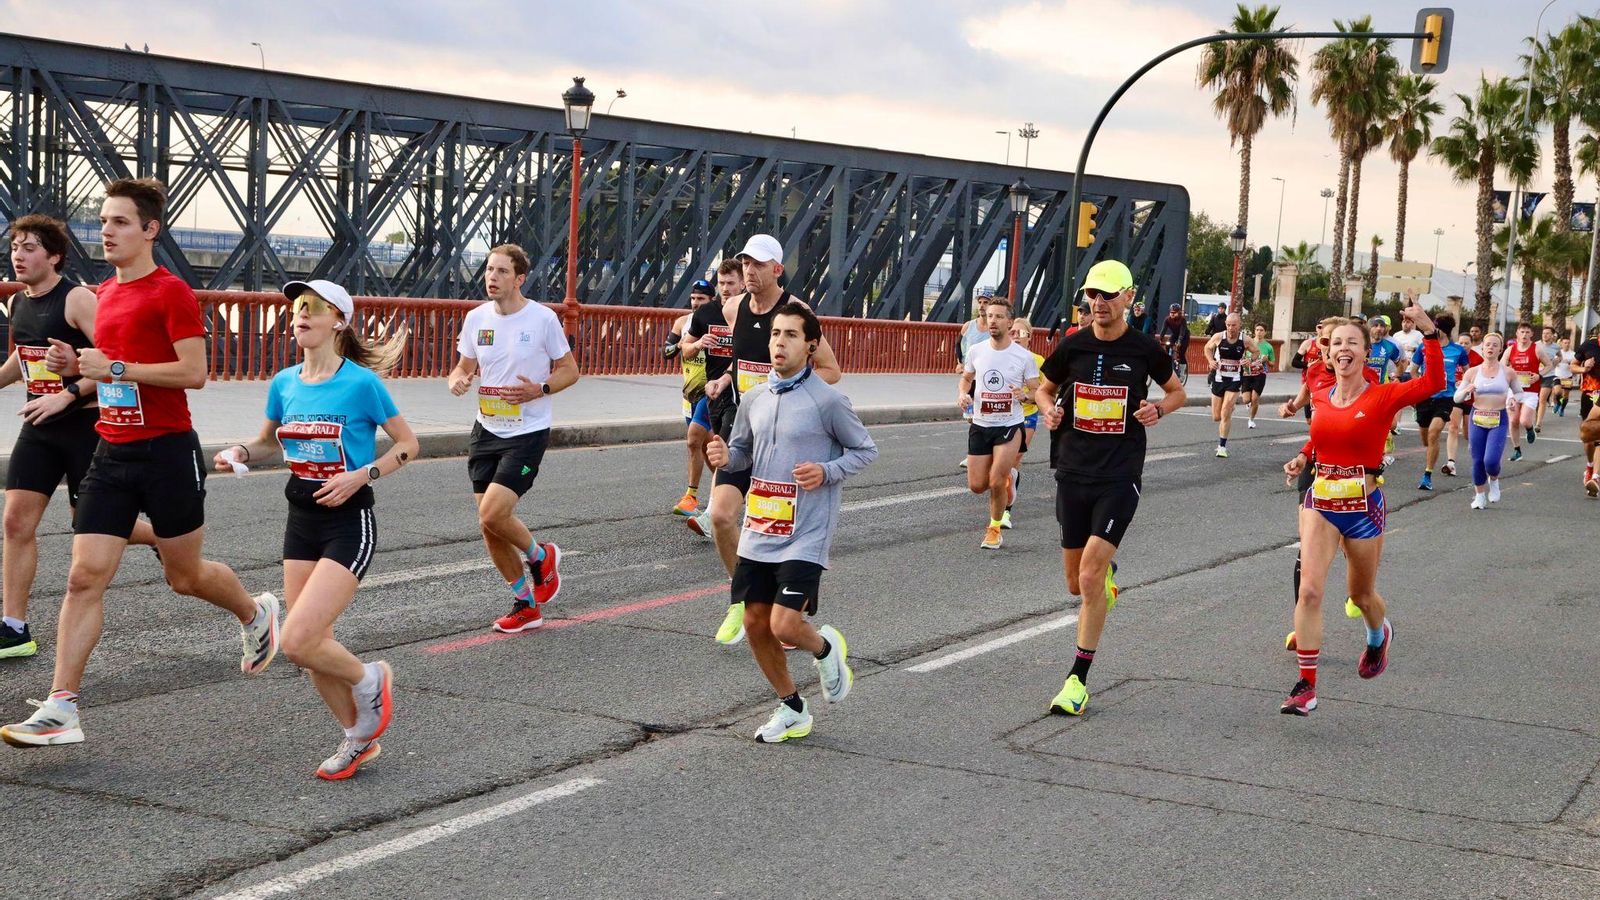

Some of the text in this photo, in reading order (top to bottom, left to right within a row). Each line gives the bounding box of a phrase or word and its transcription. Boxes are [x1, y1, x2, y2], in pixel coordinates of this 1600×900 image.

[1087, 387, 1123, 397] GENERALI
[986, 402, 1006, 410] 11482
[307, 413, 347, 426] MOSER
[296, 441, 325, 456] 3953
[757, 481, 793, 494] GENERALI
